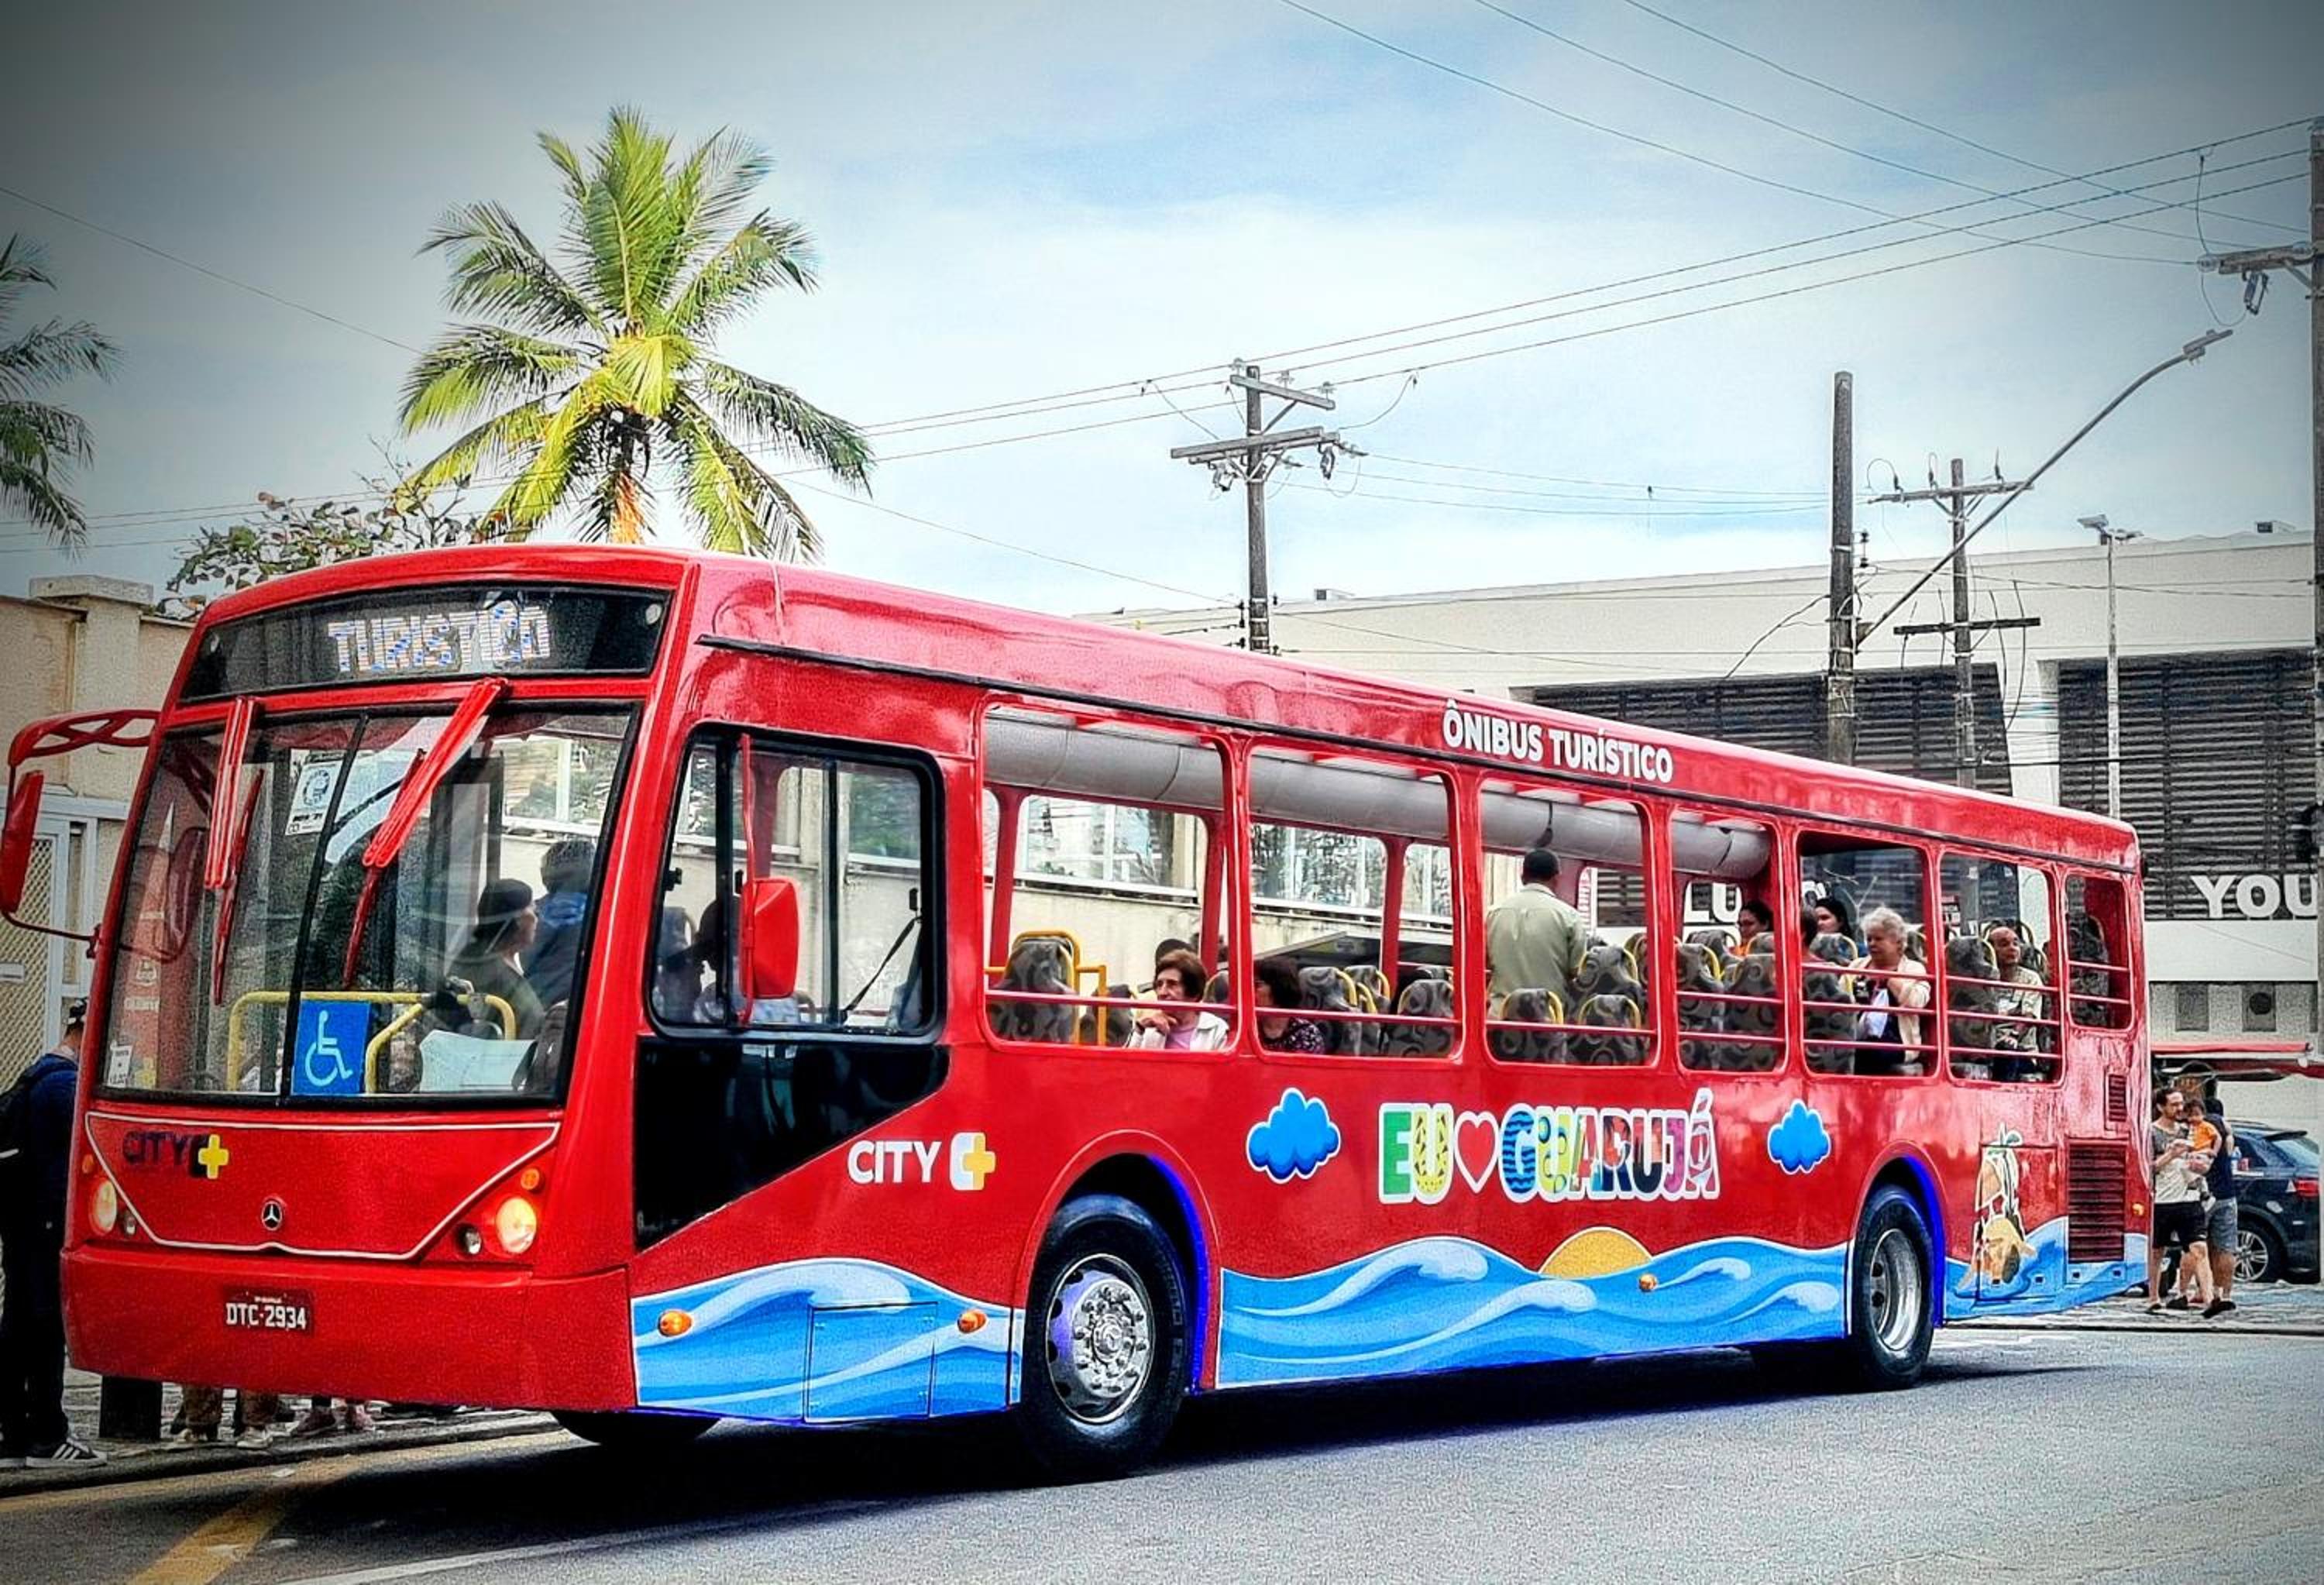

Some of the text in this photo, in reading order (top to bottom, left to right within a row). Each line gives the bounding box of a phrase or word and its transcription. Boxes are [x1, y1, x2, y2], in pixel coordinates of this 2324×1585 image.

[1442, 697, 1674, 783] ÔNIBUS TURÍSTICO
[1379, 1088, 1721, 1204] EU GUARUJÁ
[225, 1302, 307, 1330] DTC-2934
